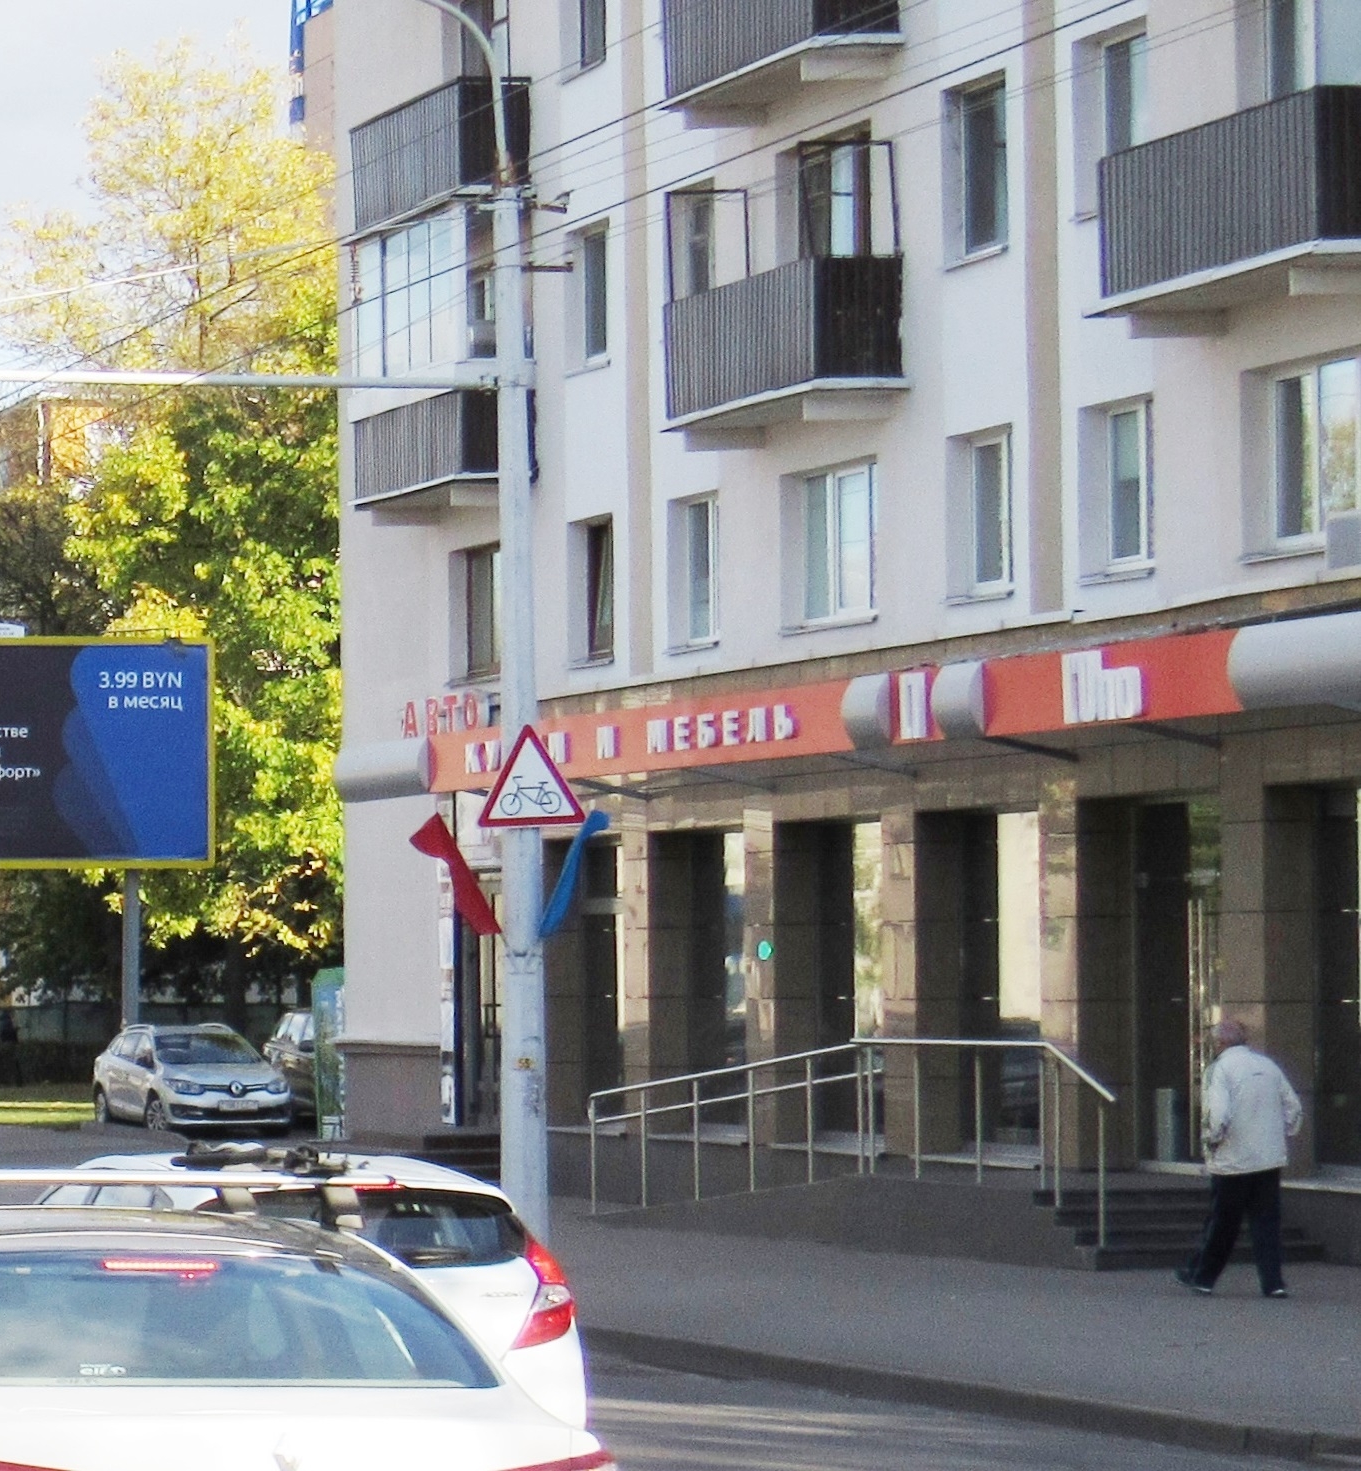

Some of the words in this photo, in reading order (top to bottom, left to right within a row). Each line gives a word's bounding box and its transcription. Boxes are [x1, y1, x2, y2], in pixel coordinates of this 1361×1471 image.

[98, 671, 138, 689] 3.99
[142, 671, 182, 689] BYN
[108, 695, 119, 709] в
[123, 695, 184, 711] месяц
[402, 693, 478, 740] АВТО
[465, 731, 567, 774] КУИ
[646, 704, 796, 754] МЕБЕЛЬ
